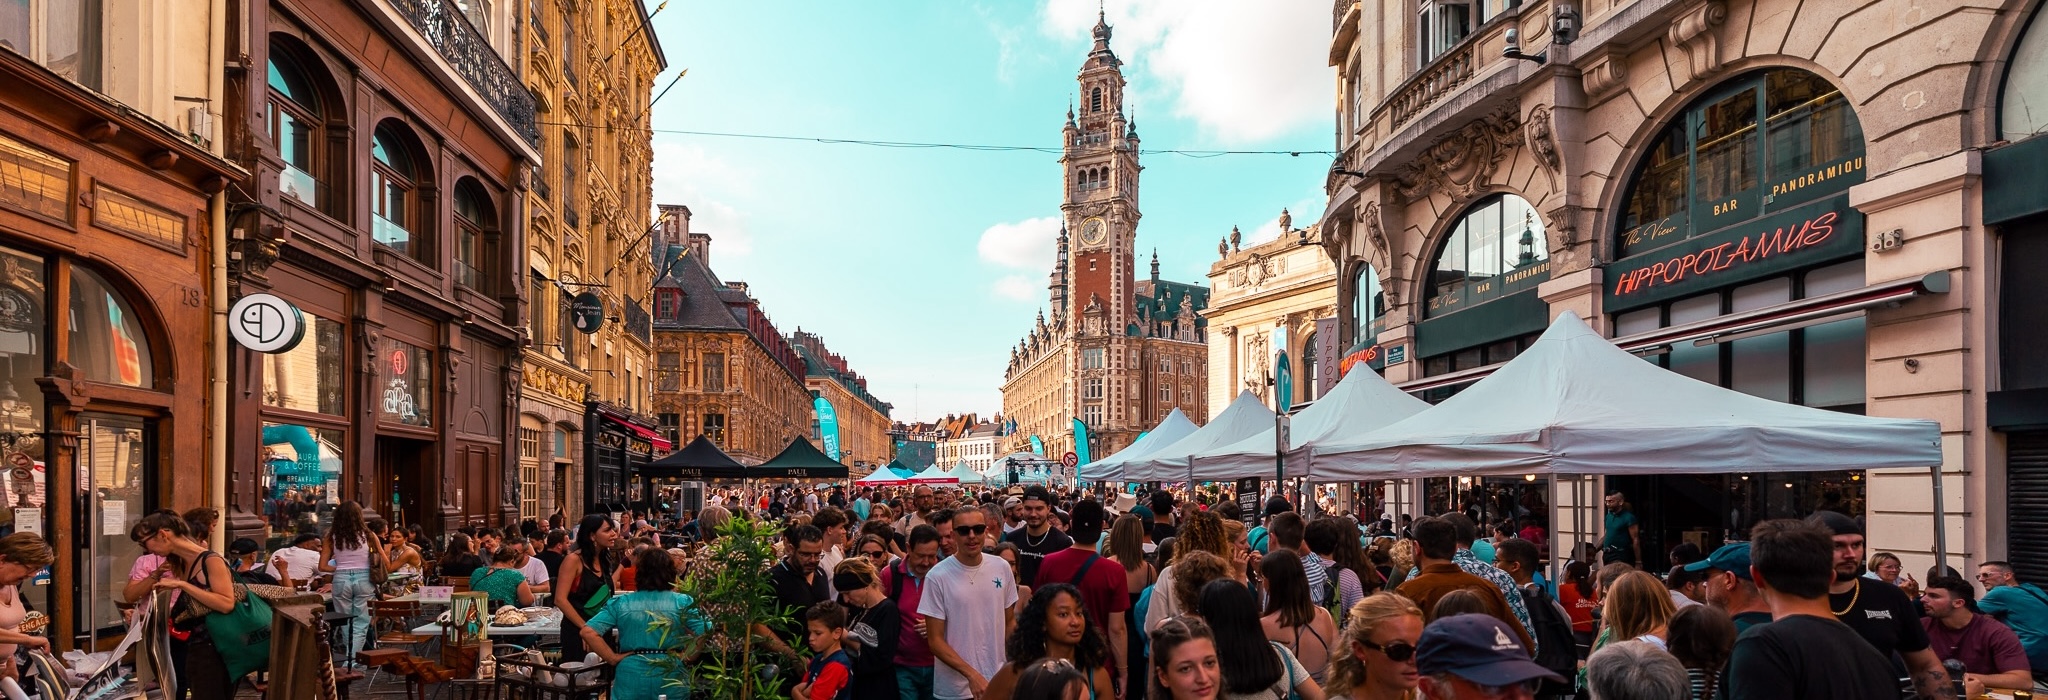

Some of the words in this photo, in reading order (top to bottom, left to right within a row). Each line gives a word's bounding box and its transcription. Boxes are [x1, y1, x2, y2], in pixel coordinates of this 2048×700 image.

[1621, 229, 1641, 249] The
[1644, 217, 1677, 240] View
[1714, 199, 1737, 216] BAR
[1773, 157, 1862, 196] PANORAMIQU
[1615, 212, 1838, 295] HIPPOPOTAMUS
[181, 286, 199, 307] 18
[1428, 298, 1440, 311] The
[1441, 292, 1459, 307] View
[1477, 283, 1490, 294] BAR
[1505, 262, 1550, 284] PANORAMIQU
[293, 462, 321, 471] COFFEE
[287, 475, 319, 483] BREAKFAST
[1240, 494, 1257, 503] MOULES
